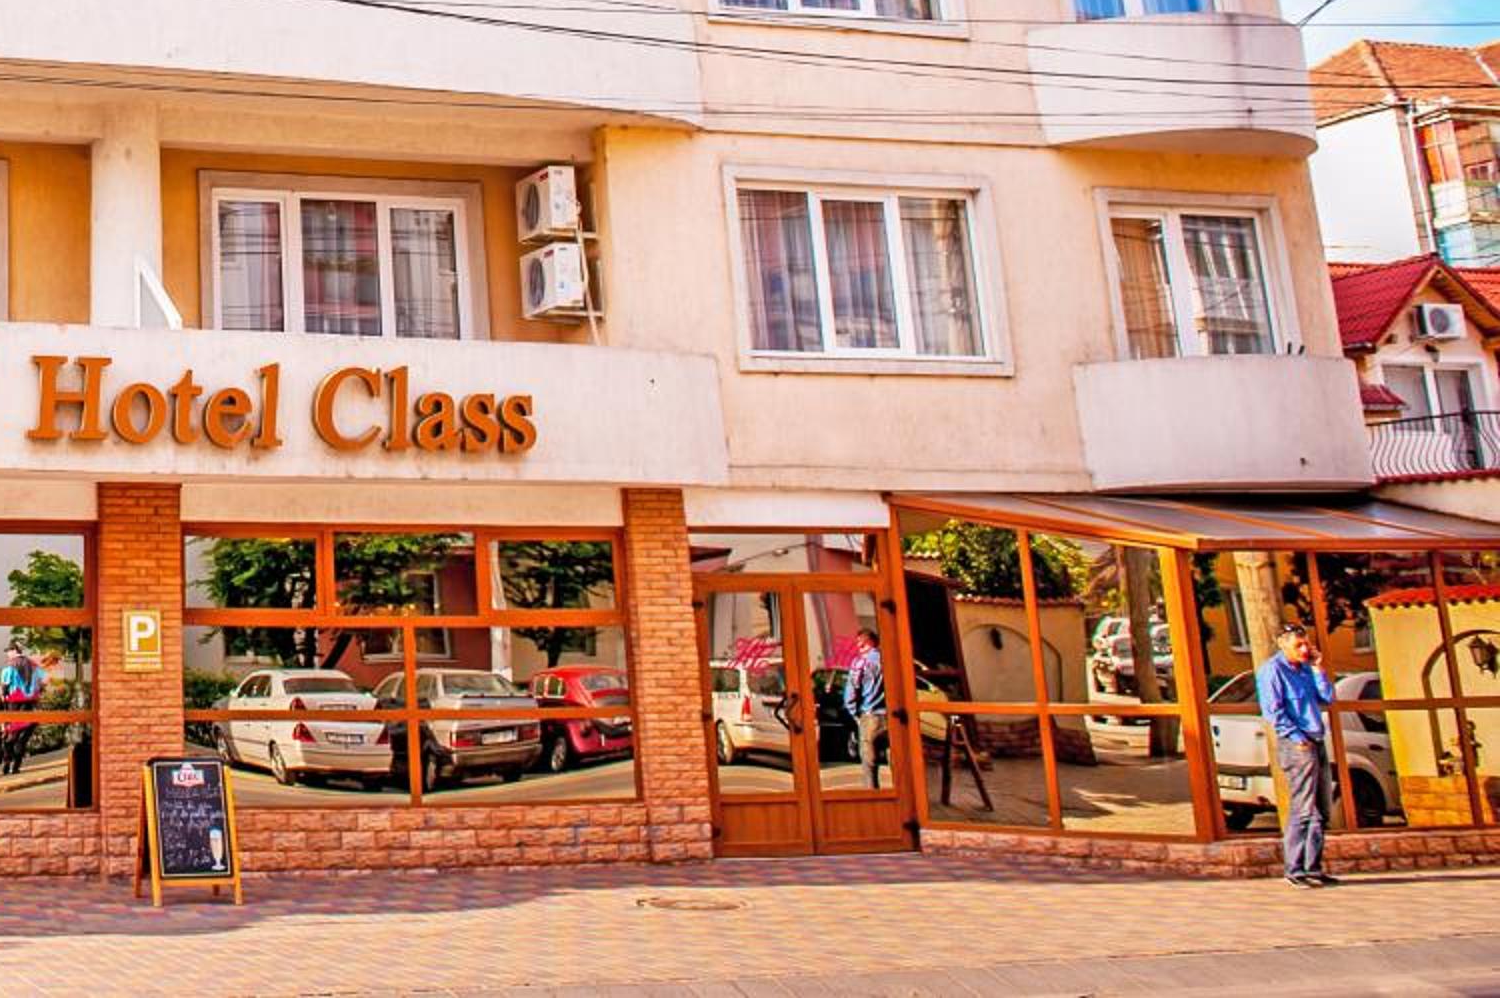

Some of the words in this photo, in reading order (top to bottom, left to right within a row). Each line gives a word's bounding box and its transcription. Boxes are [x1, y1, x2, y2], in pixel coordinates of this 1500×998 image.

[25, 355, 283, 450] Hotel
[312, 366, 537, 455] Class
[129, 615, 156, 651] P
